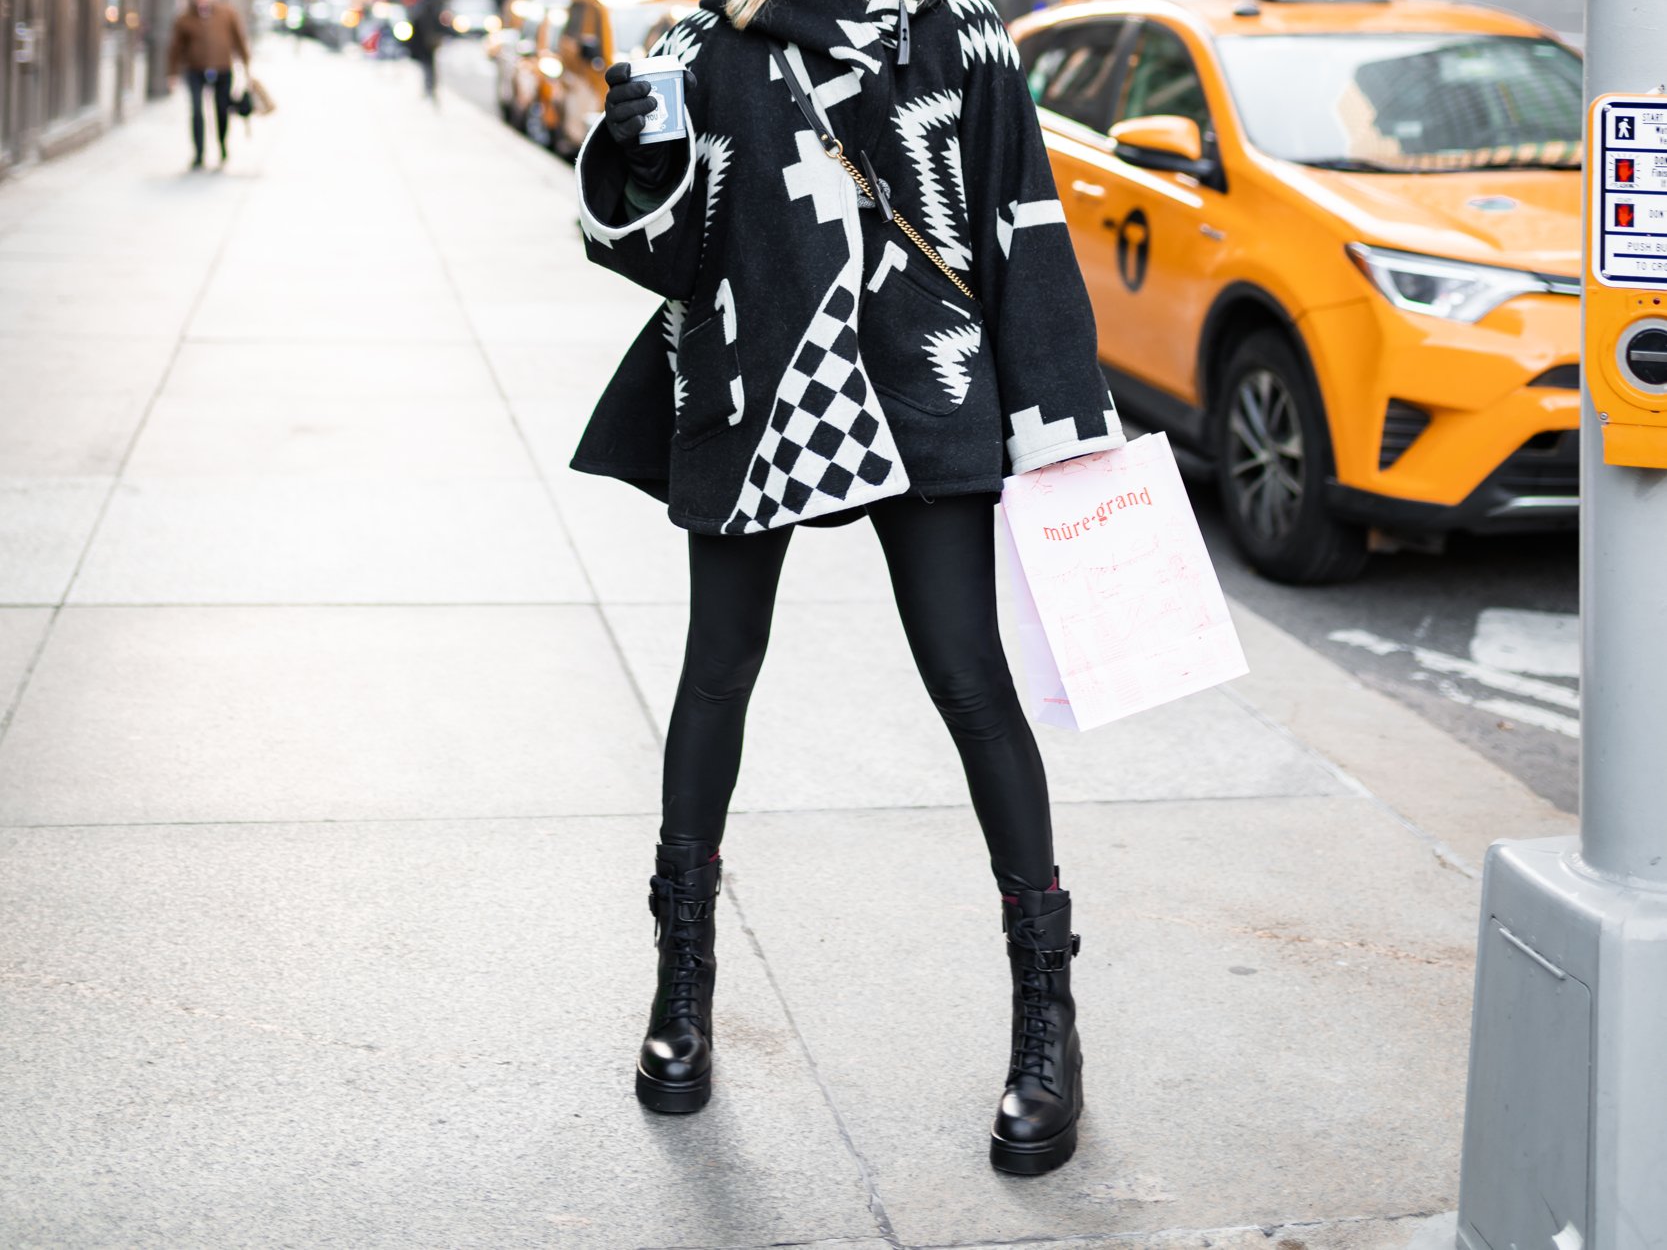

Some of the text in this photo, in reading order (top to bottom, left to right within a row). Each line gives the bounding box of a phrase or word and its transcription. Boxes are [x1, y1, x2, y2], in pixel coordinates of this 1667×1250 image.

[1628, 241, 1651, 252] PUSH
[1636, 261, 1647, 271] TO
[1043, 487, 1152, 541] mûre-grand
